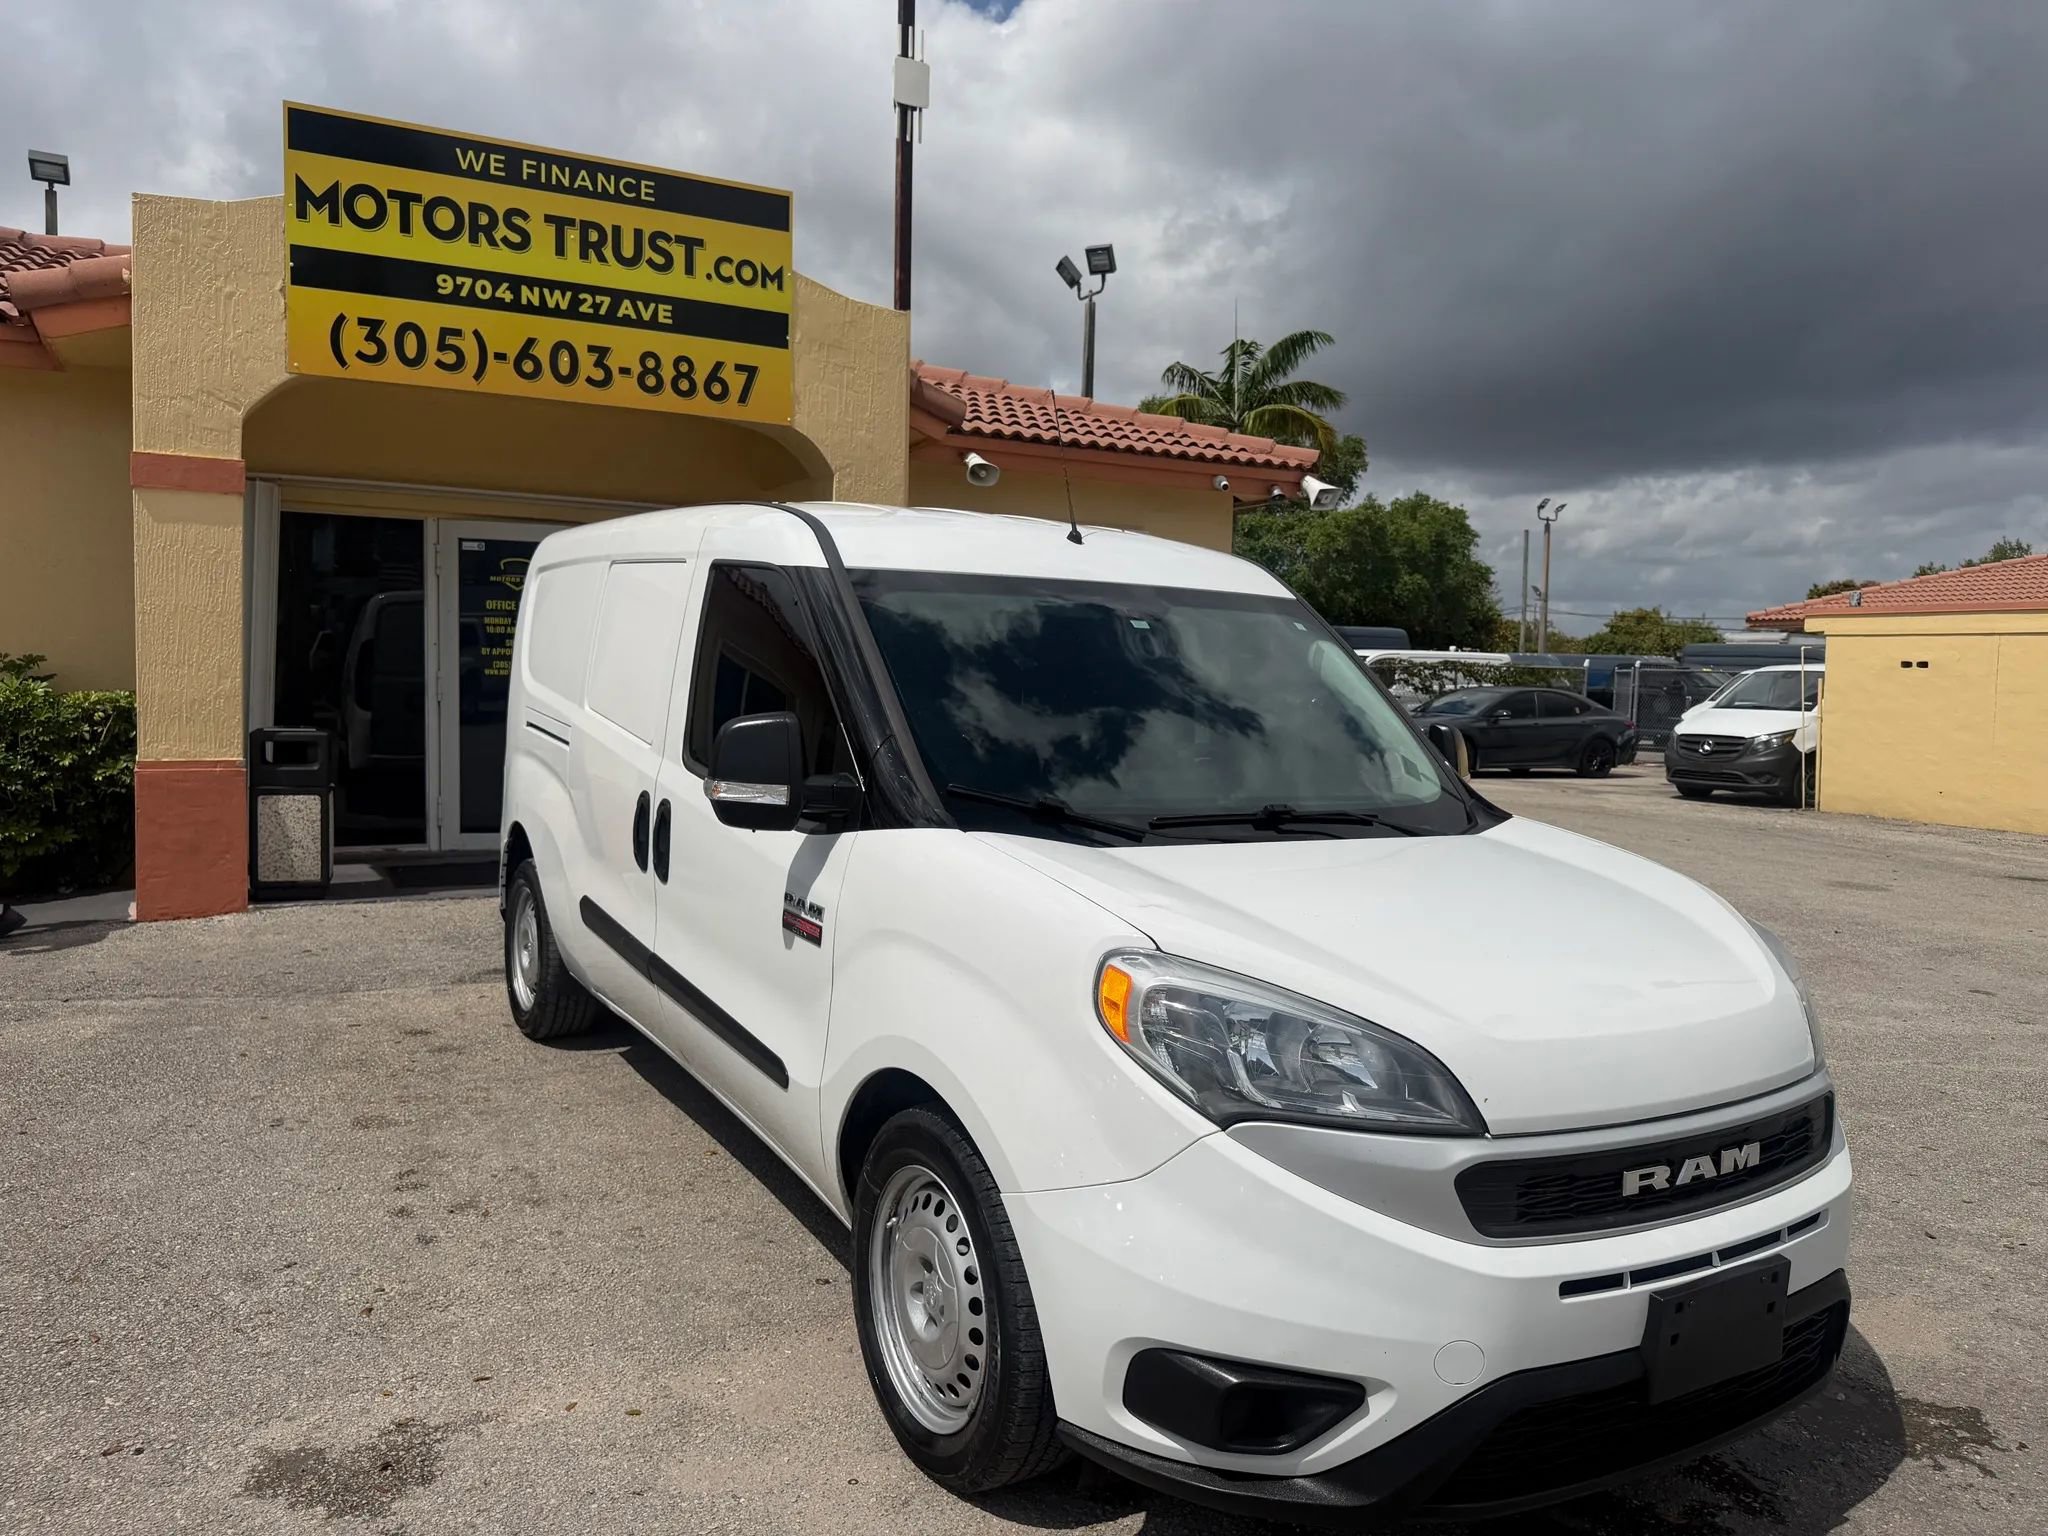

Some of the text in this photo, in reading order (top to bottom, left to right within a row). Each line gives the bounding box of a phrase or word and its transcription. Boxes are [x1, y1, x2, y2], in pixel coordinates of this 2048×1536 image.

[454, 147, 657, 204] WE FINANCE
[294, 173, 533, 254] MOTORS
[436, 273, 674, 326] 9704 NW 27 AVE
[328, 312, 760, 407] (305)-603-8867
[484, 616, 512, 625] MONDAY
[485, 600, 517, 611] OFFICE
[784, 892, 825, 923] RAM
[1621, 1141, 1761, 1197] RAM
